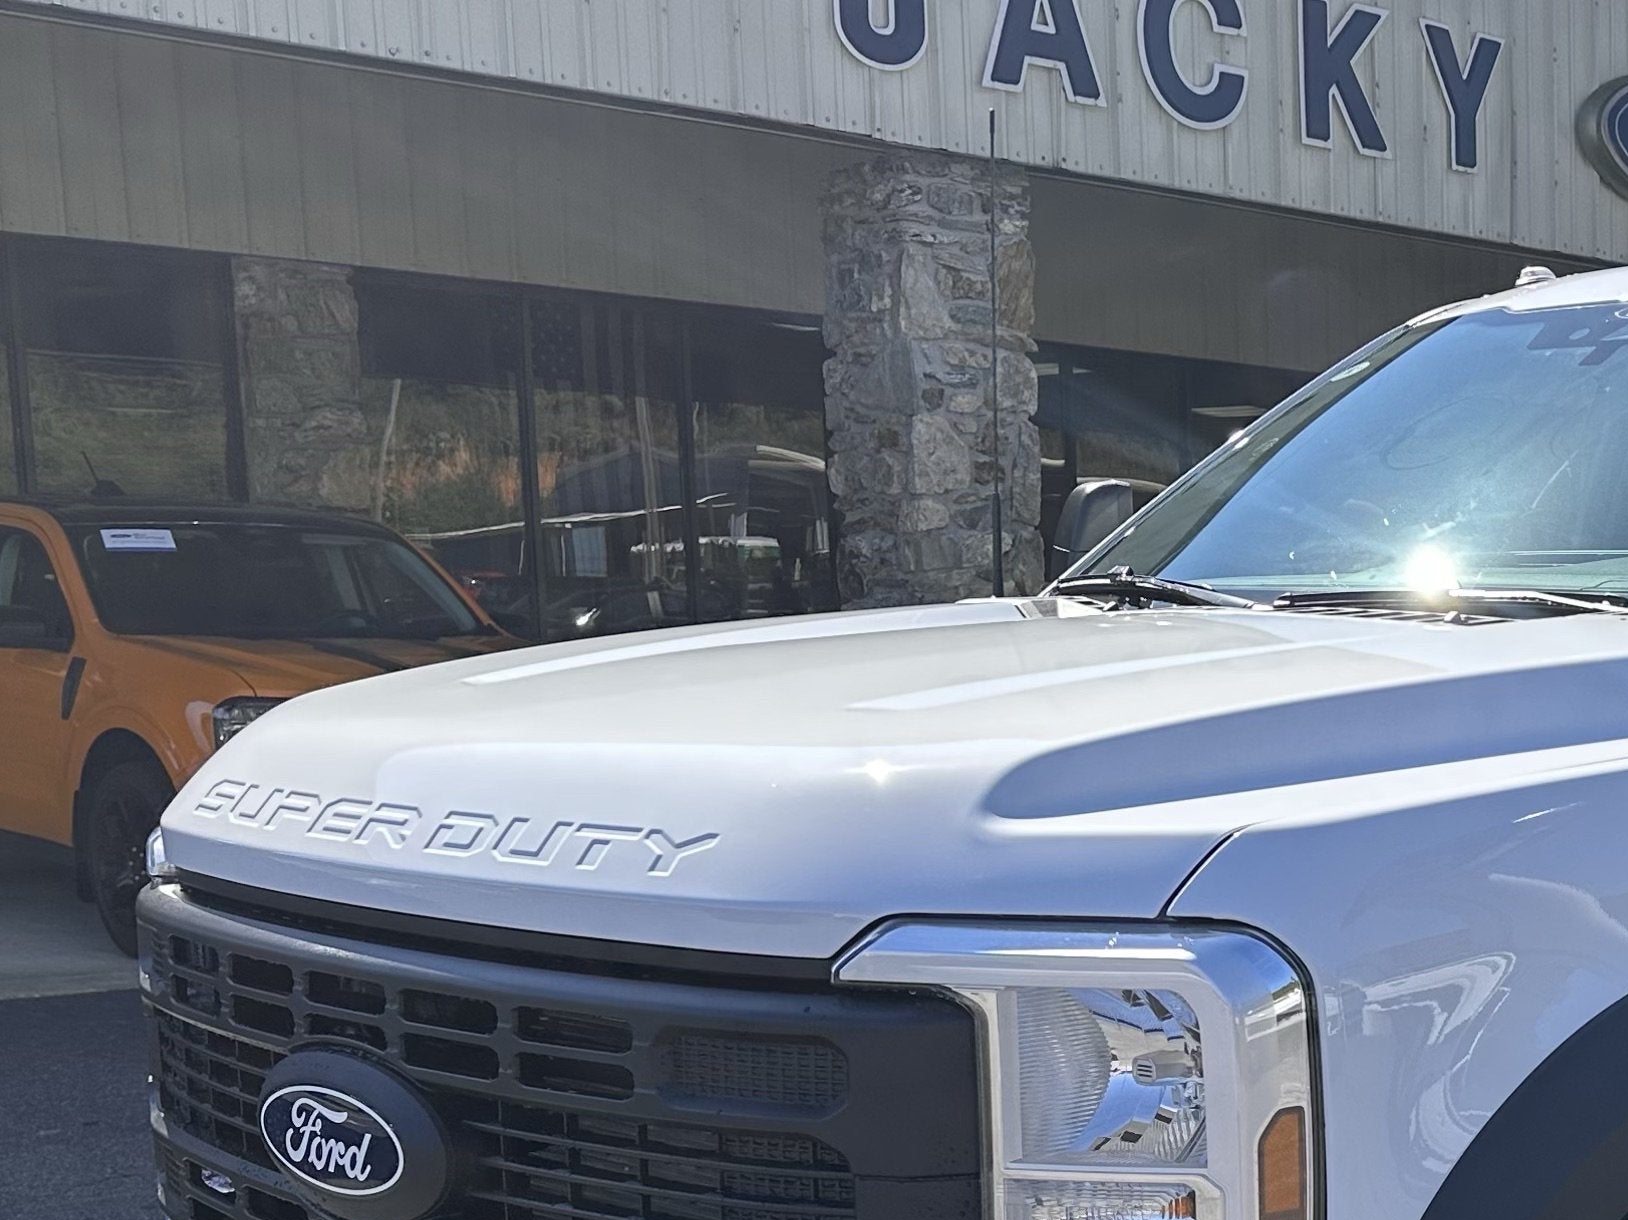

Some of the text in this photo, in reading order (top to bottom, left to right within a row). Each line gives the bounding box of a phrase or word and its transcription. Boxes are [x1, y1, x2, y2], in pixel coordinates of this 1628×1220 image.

[193, 778, 722, 878] SUPER DUTY
[285, 1097, 372, 1182] Ford
